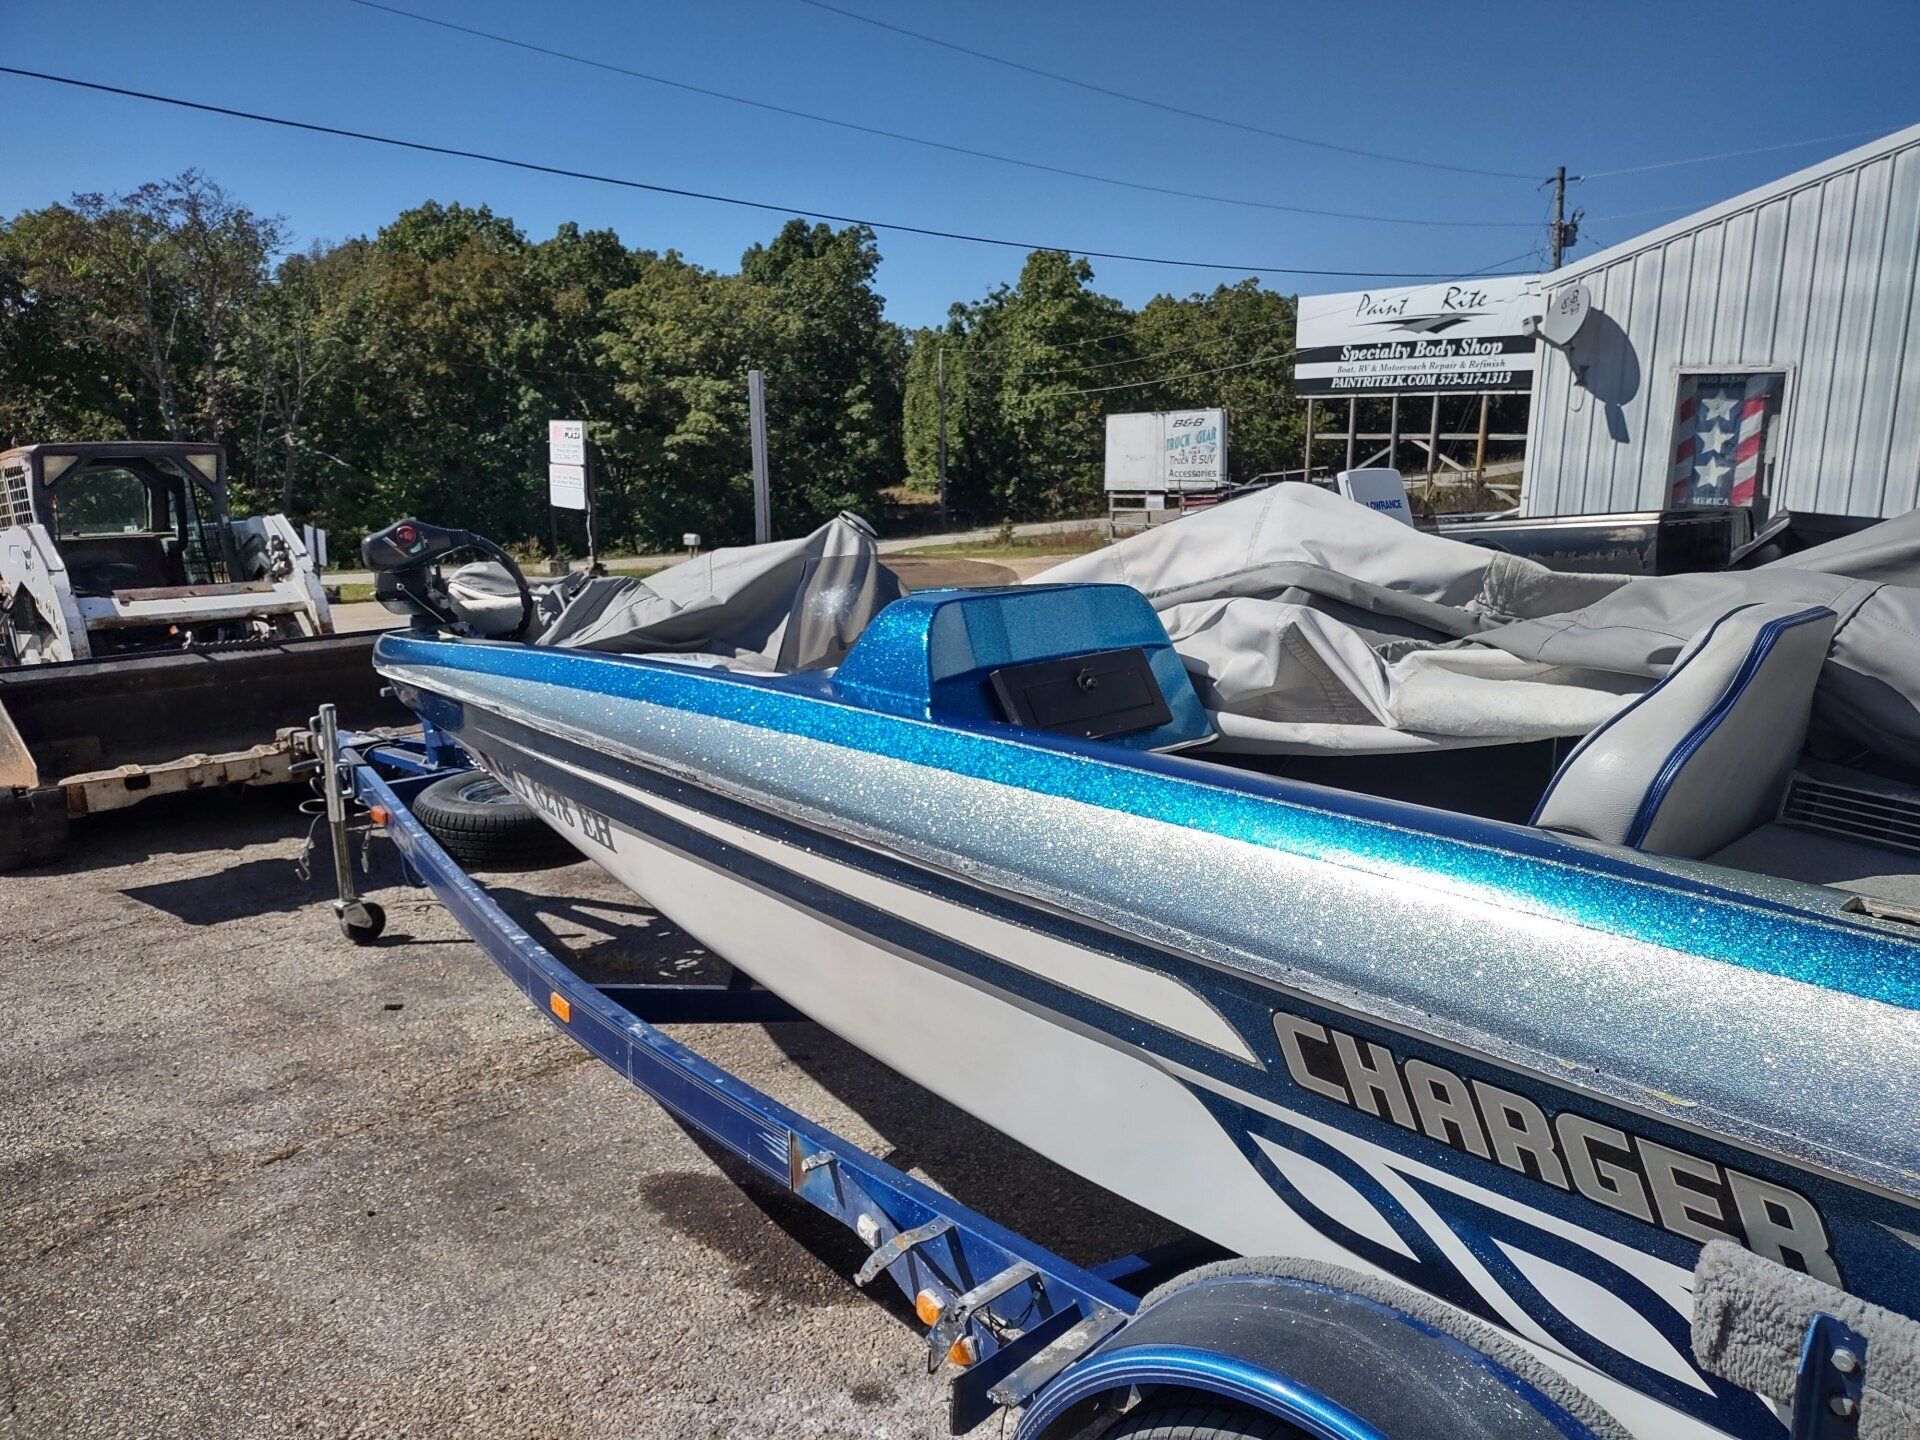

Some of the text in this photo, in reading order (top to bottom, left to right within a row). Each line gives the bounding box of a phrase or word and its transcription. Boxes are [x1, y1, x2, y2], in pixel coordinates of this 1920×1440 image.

[1356, 286, 1487, 317] Paint Rite
[1340, 338, 1503, 364] Specialty Body Shop
[1358, 364, 1370, 373] RV
[1371, 364, 1377, 372] &
[1379, 361, 1426, 372] Motorcoach
[1429, 361, 1457, 371] Repair
[1460, 360, 1466, 368] &
[1469, 358, 1506, 370] Refinish
[1331, 371, 1512, 388] PAINTRITELK.COM 573-317-1313
[1166, 426, 1217, 451] TRUCK GEAR
[1170, 455, 1189, 466] Truck
[1199, 454, 1216, 465] SUV
[1169, 469, 1217, 478] Accessories
[1688, 496, 1729, 506] MERICA
[576, 802, 618, 855] EH
[1271, 1011, 1845, 1291] CHARGER
